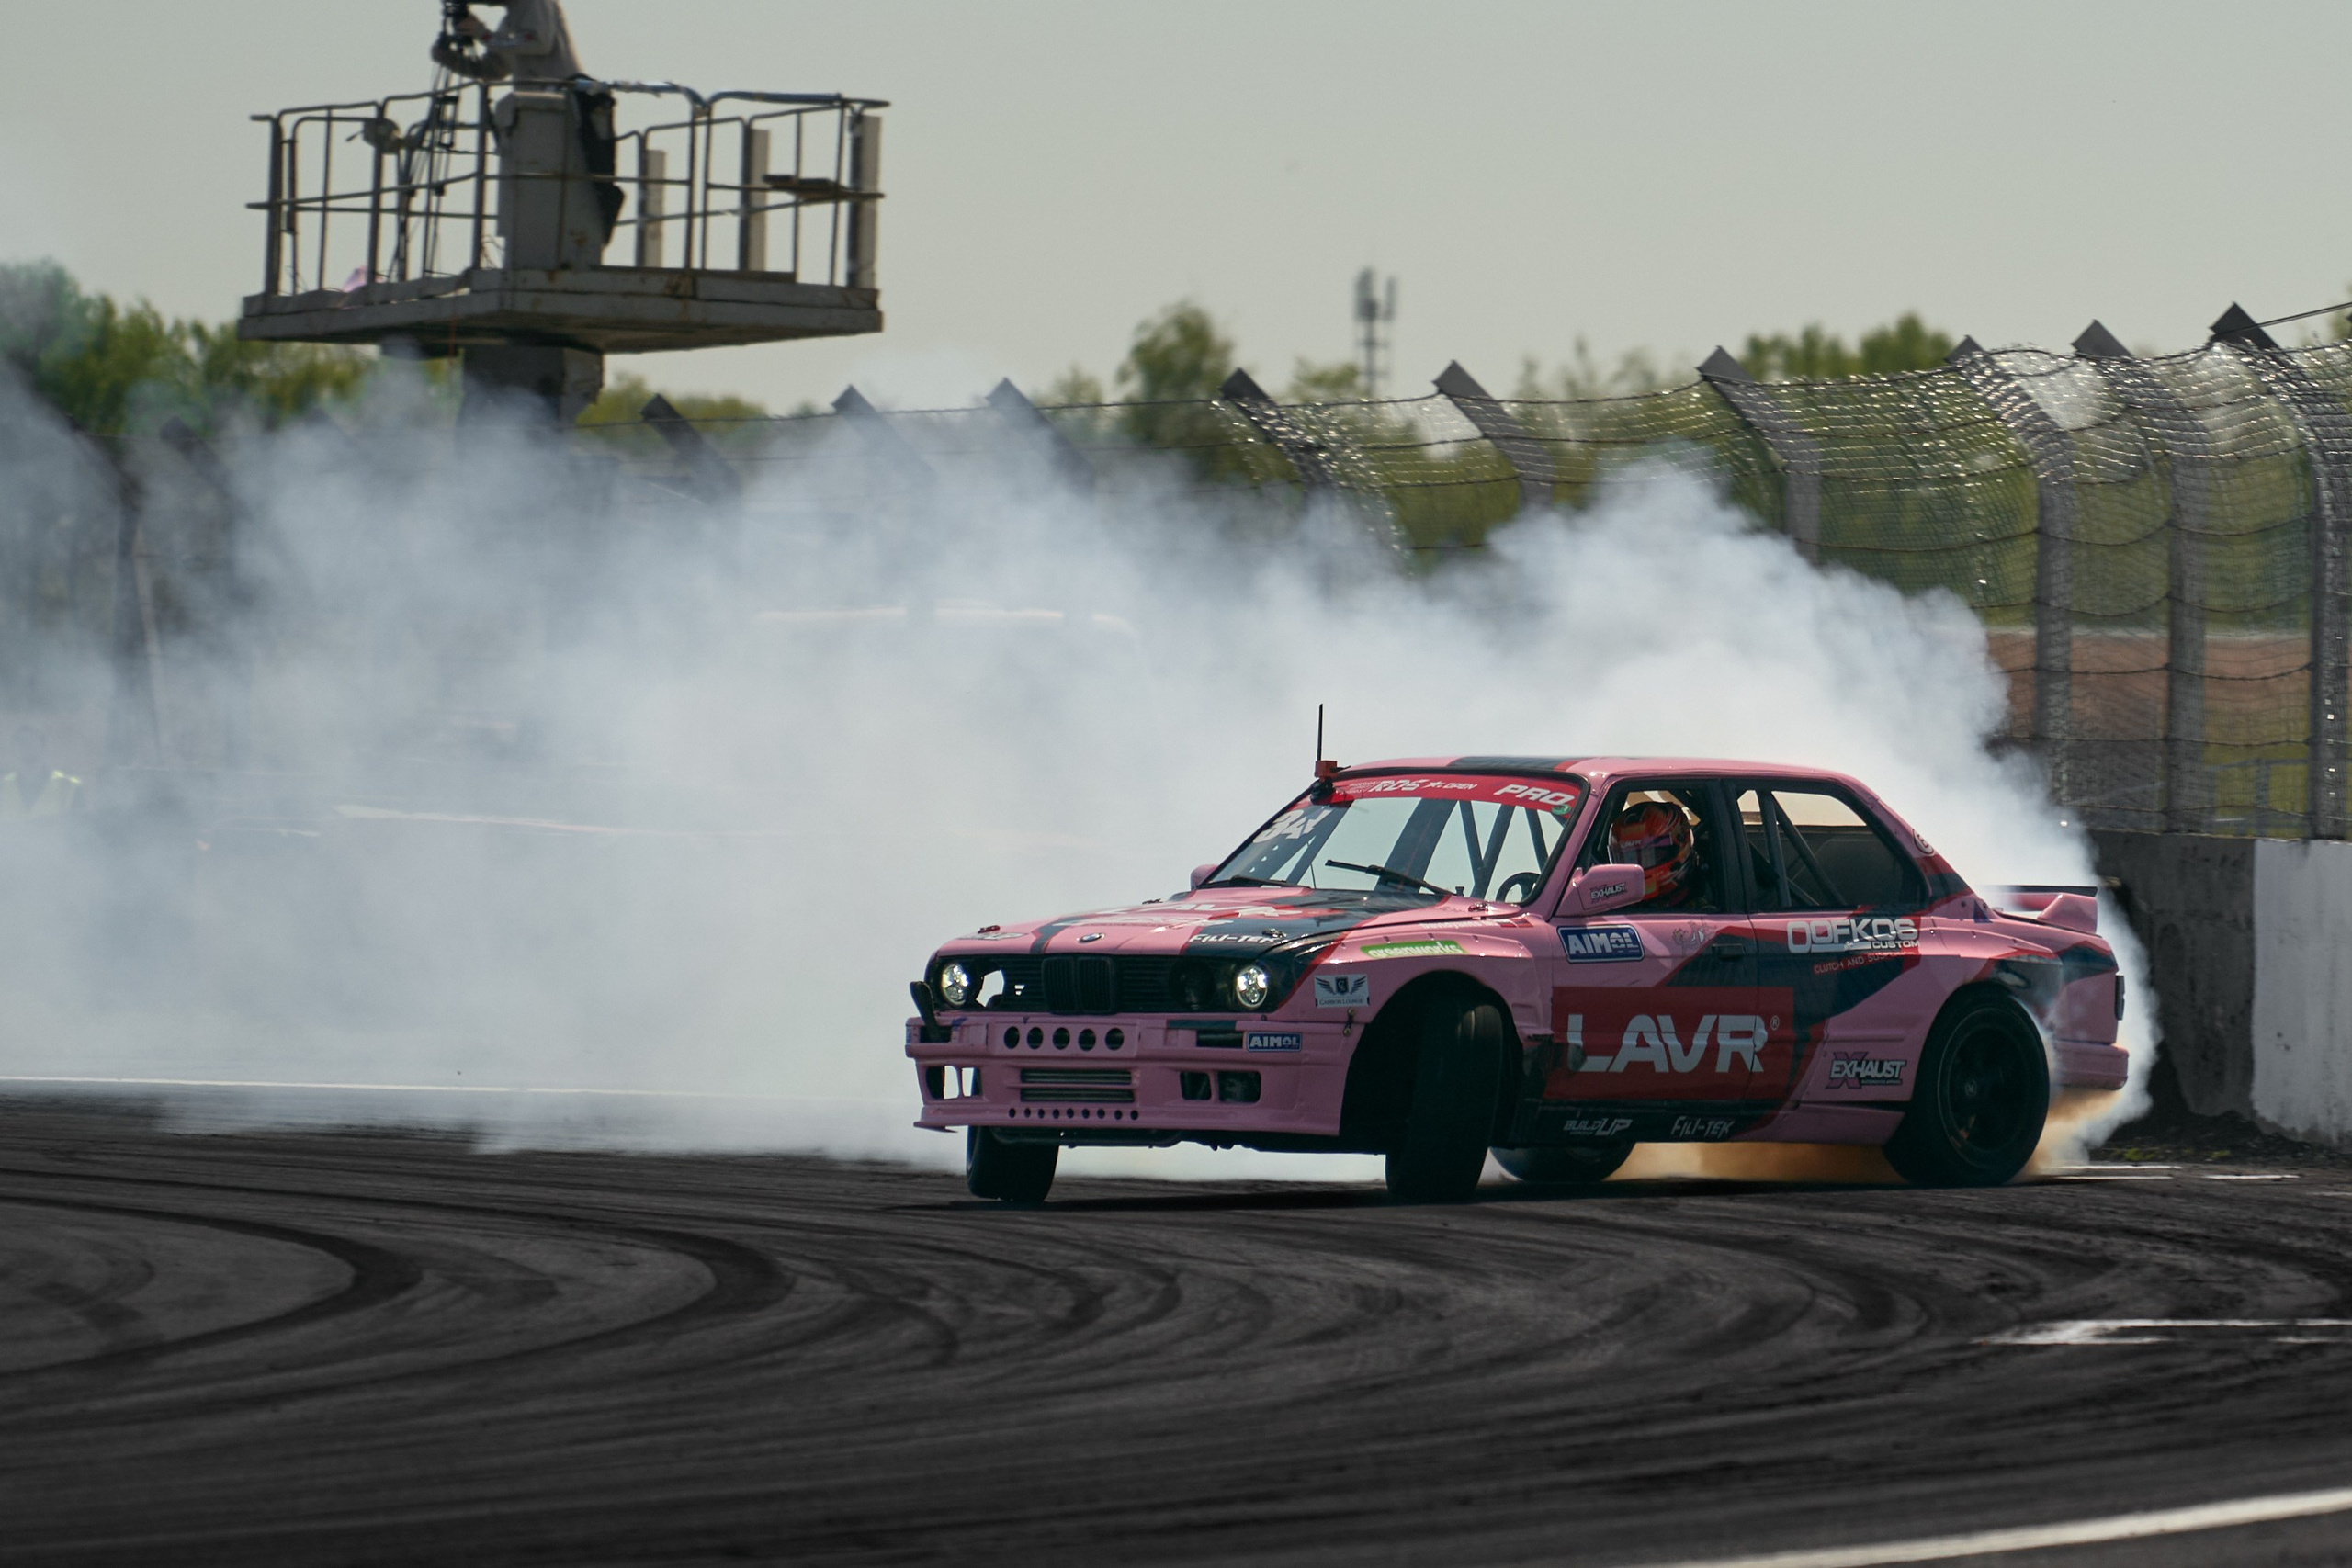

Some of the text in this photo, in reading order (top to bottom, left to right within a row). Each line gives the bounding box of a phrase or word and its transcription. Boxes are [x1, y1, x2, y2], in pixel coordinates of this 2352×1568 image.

[1367, 779, 1430, 793] RDS
[1494, 784, 1575, 806] PRO
[1590, 883, 1626, 899] EXHAUST
[1368, 941, 1464, 958] greenworks
[1567, 931, 1639, 955] AIMOL
[1871, 940, 1920, 949] CUSTOM
[1815, 960, 1844, 974] CLUTCH
[1847, 955, 1865, 967] AND
[1250, 1036, 1299, 1047] AIMOL
[1566, 1014, 1768, 1073] LAVR
[1829, 1059, 1907, 1078] EXHAUST
[1670, 1115, 1736, 1139] FILI-TEK
